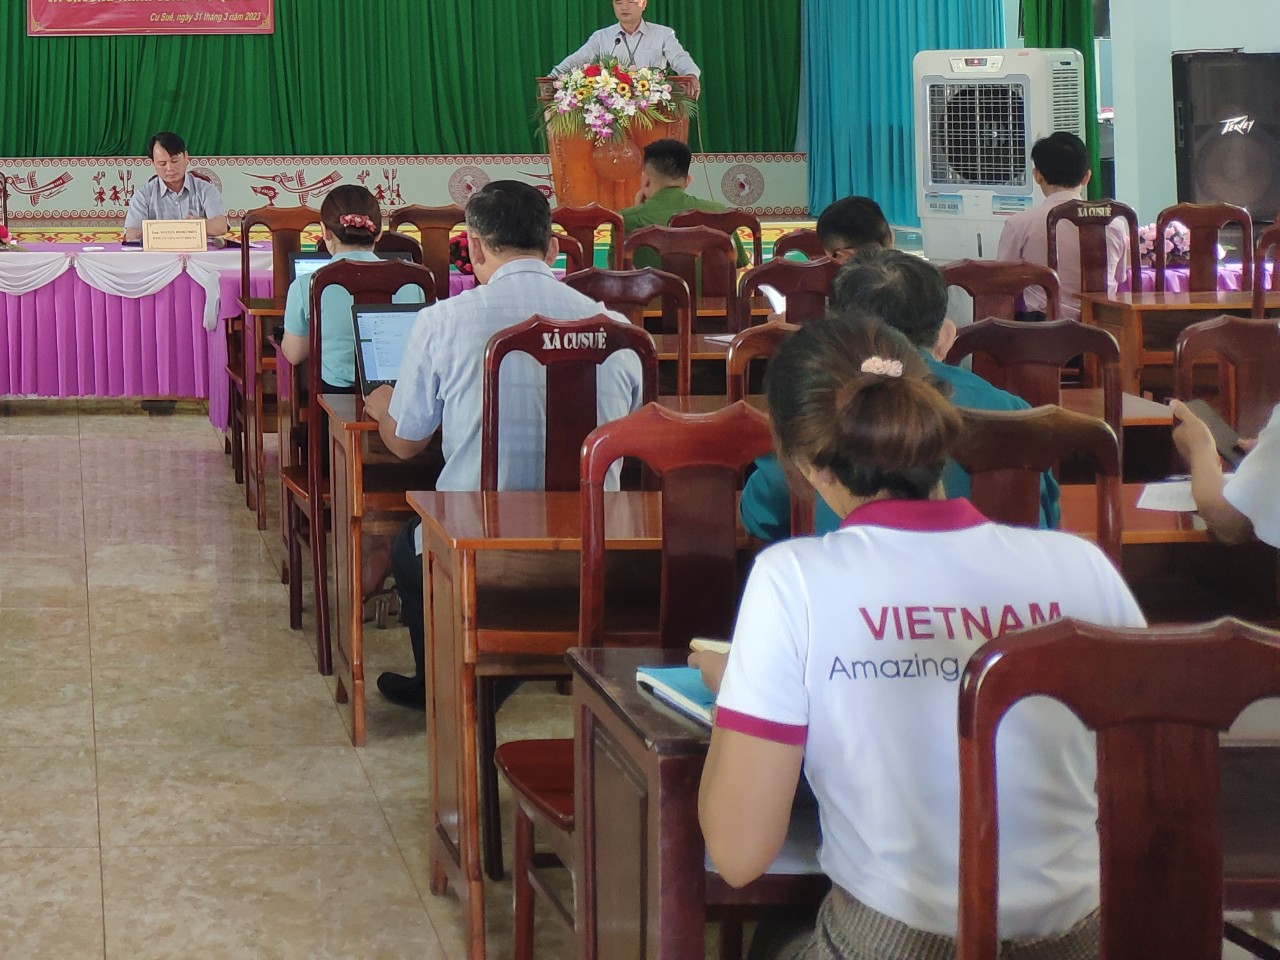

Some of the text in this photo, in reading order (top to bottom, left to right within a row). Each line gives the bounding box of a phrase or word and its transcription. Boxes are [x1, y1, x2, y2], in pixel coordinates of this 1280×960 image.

[150, 13, 160, 22] Cư
[177, 13, 193, 24] ngày
[194, 12, 202, 22] 31
[204, 12, 223, 23] tháng
[224, 12, 228, 21] 3
[229, 12, 244, 21] năm
[245, 12, 261, 21] 2023
[542, 329, 561, 349] XÃ
[859, 602, 1062, 640] VIETNAM
[829, 654, 959, 682] Amazing
